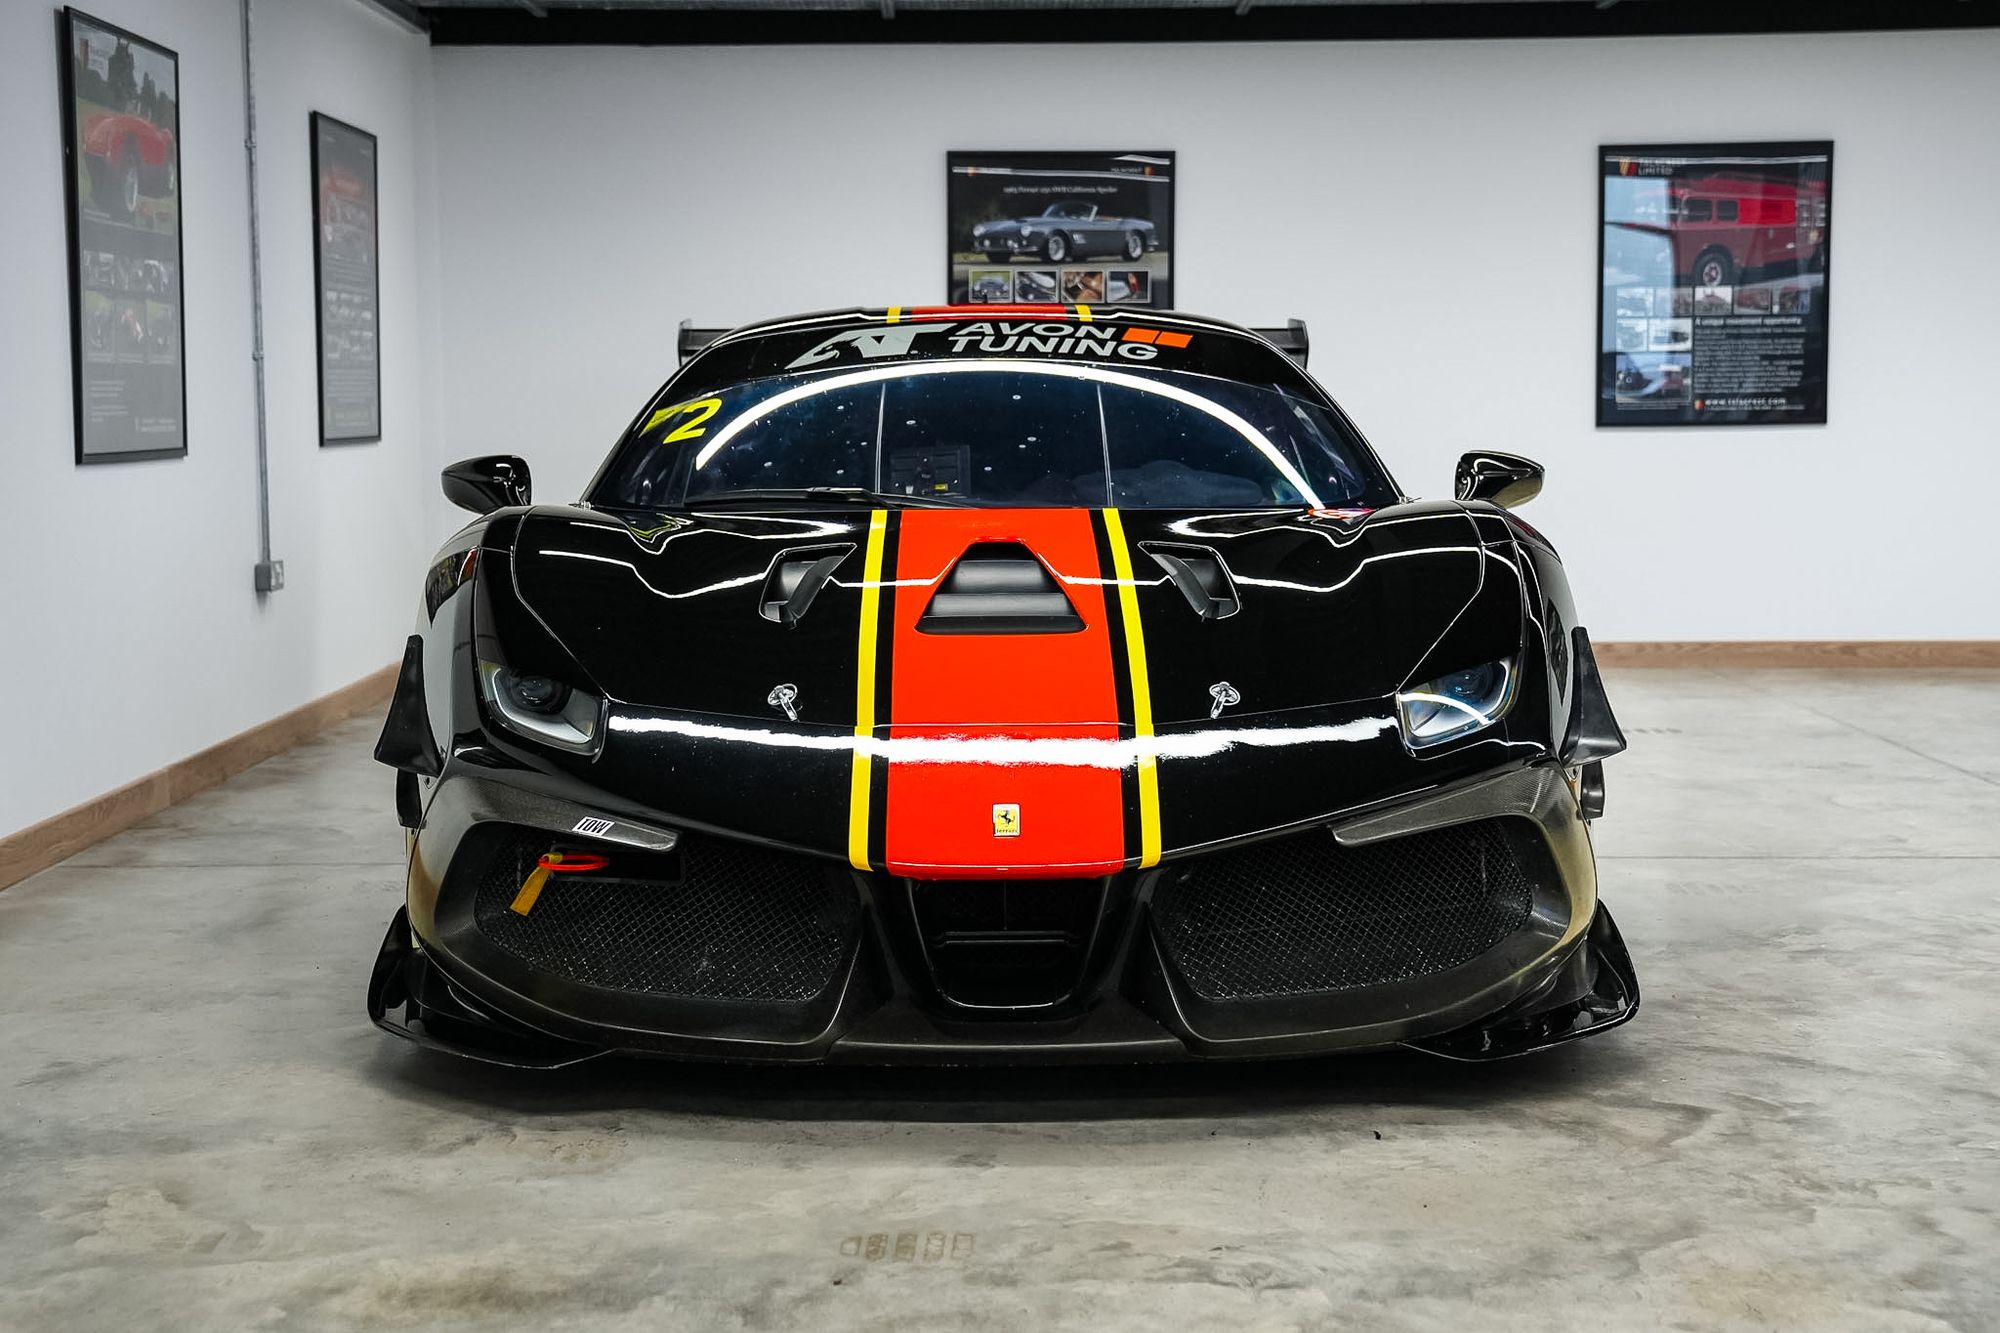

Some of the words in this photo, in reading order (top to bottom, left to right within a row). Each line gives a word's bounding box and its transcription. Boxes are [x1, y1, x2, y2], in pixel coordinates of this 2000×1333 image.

[955, 322, 1117, 340] AVON
[948, 335, 1158, 360] TUNING
[577, 818, 611, 834] TOW
